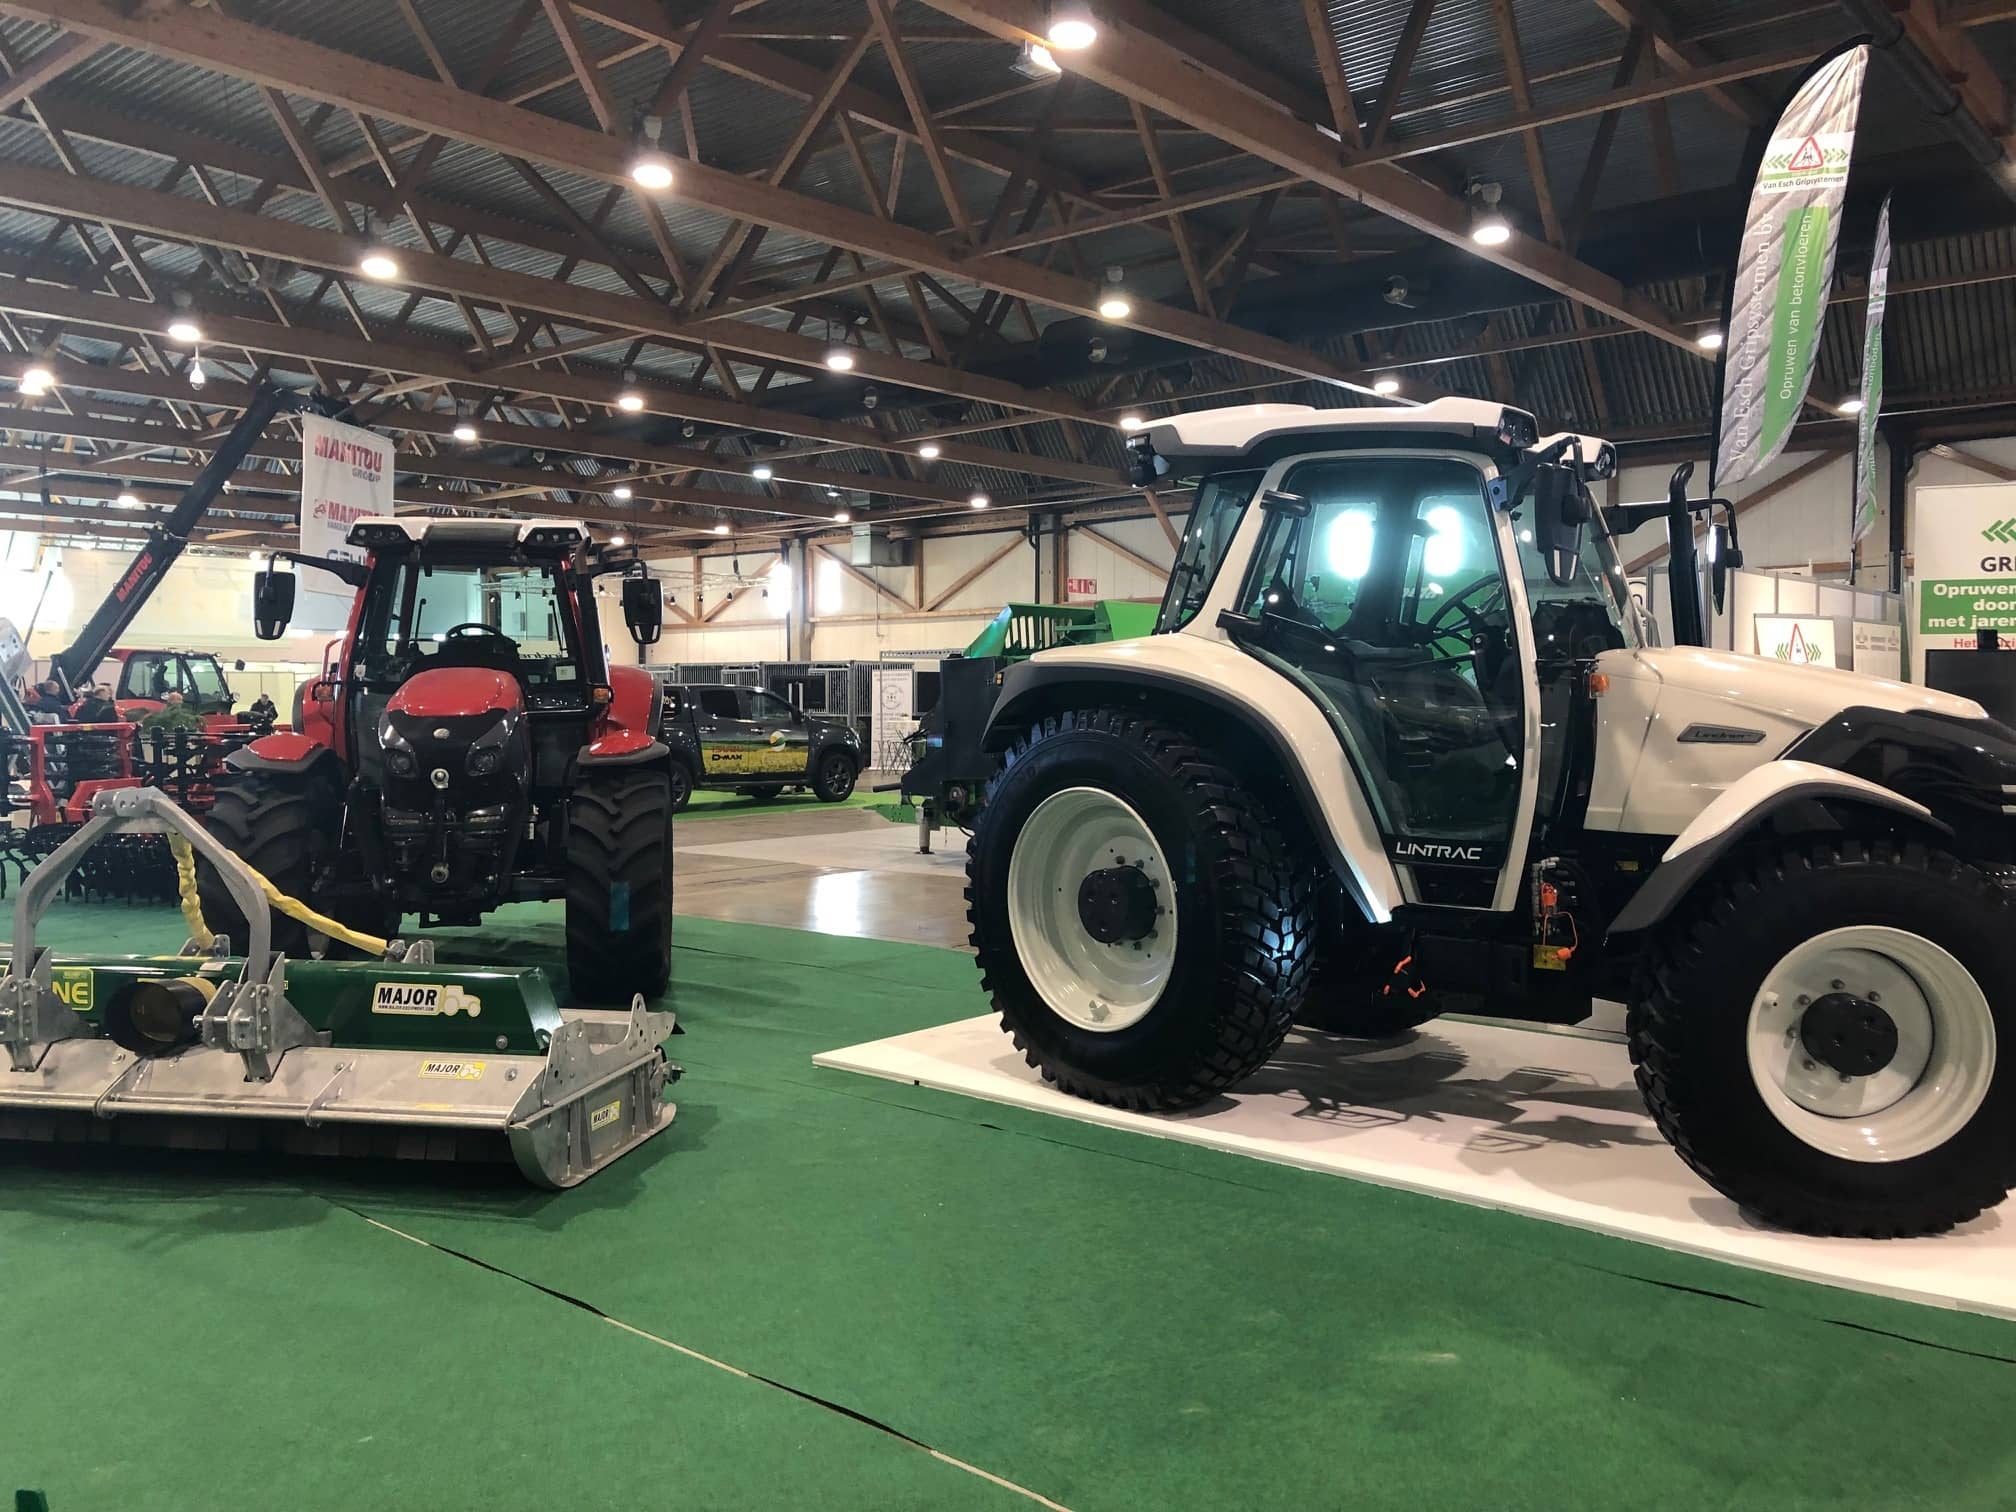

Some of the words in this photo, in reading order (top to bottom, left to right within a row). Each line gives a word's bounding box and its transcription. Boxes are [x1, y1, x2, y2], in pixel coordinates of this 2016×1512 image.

[1778, 180, 1794, 188] Esch
[1795, 176, 1844, 186] Gripsystemen
[1788, 215, 1812, 305] betonvloeren
[1740, 241, 1770, 370] Gripsystemen
[1789, 310, 1801, 335] van
[1780, 339, 1798, 400] Opruwen
[1735, 377, 1753, 419] Esch
[315, 434, 382, 473] MANITOU
[1730, 426, 1748, 461] Van
[351, 466, 381, 483] GROUP
[1928, 615, 1966, 627] met
[1396, 841, 1482, 860] LINTRAC
[377, 987, 437, 1006] MAJOR
[425, 1063, 461, 1073] MAJOR
